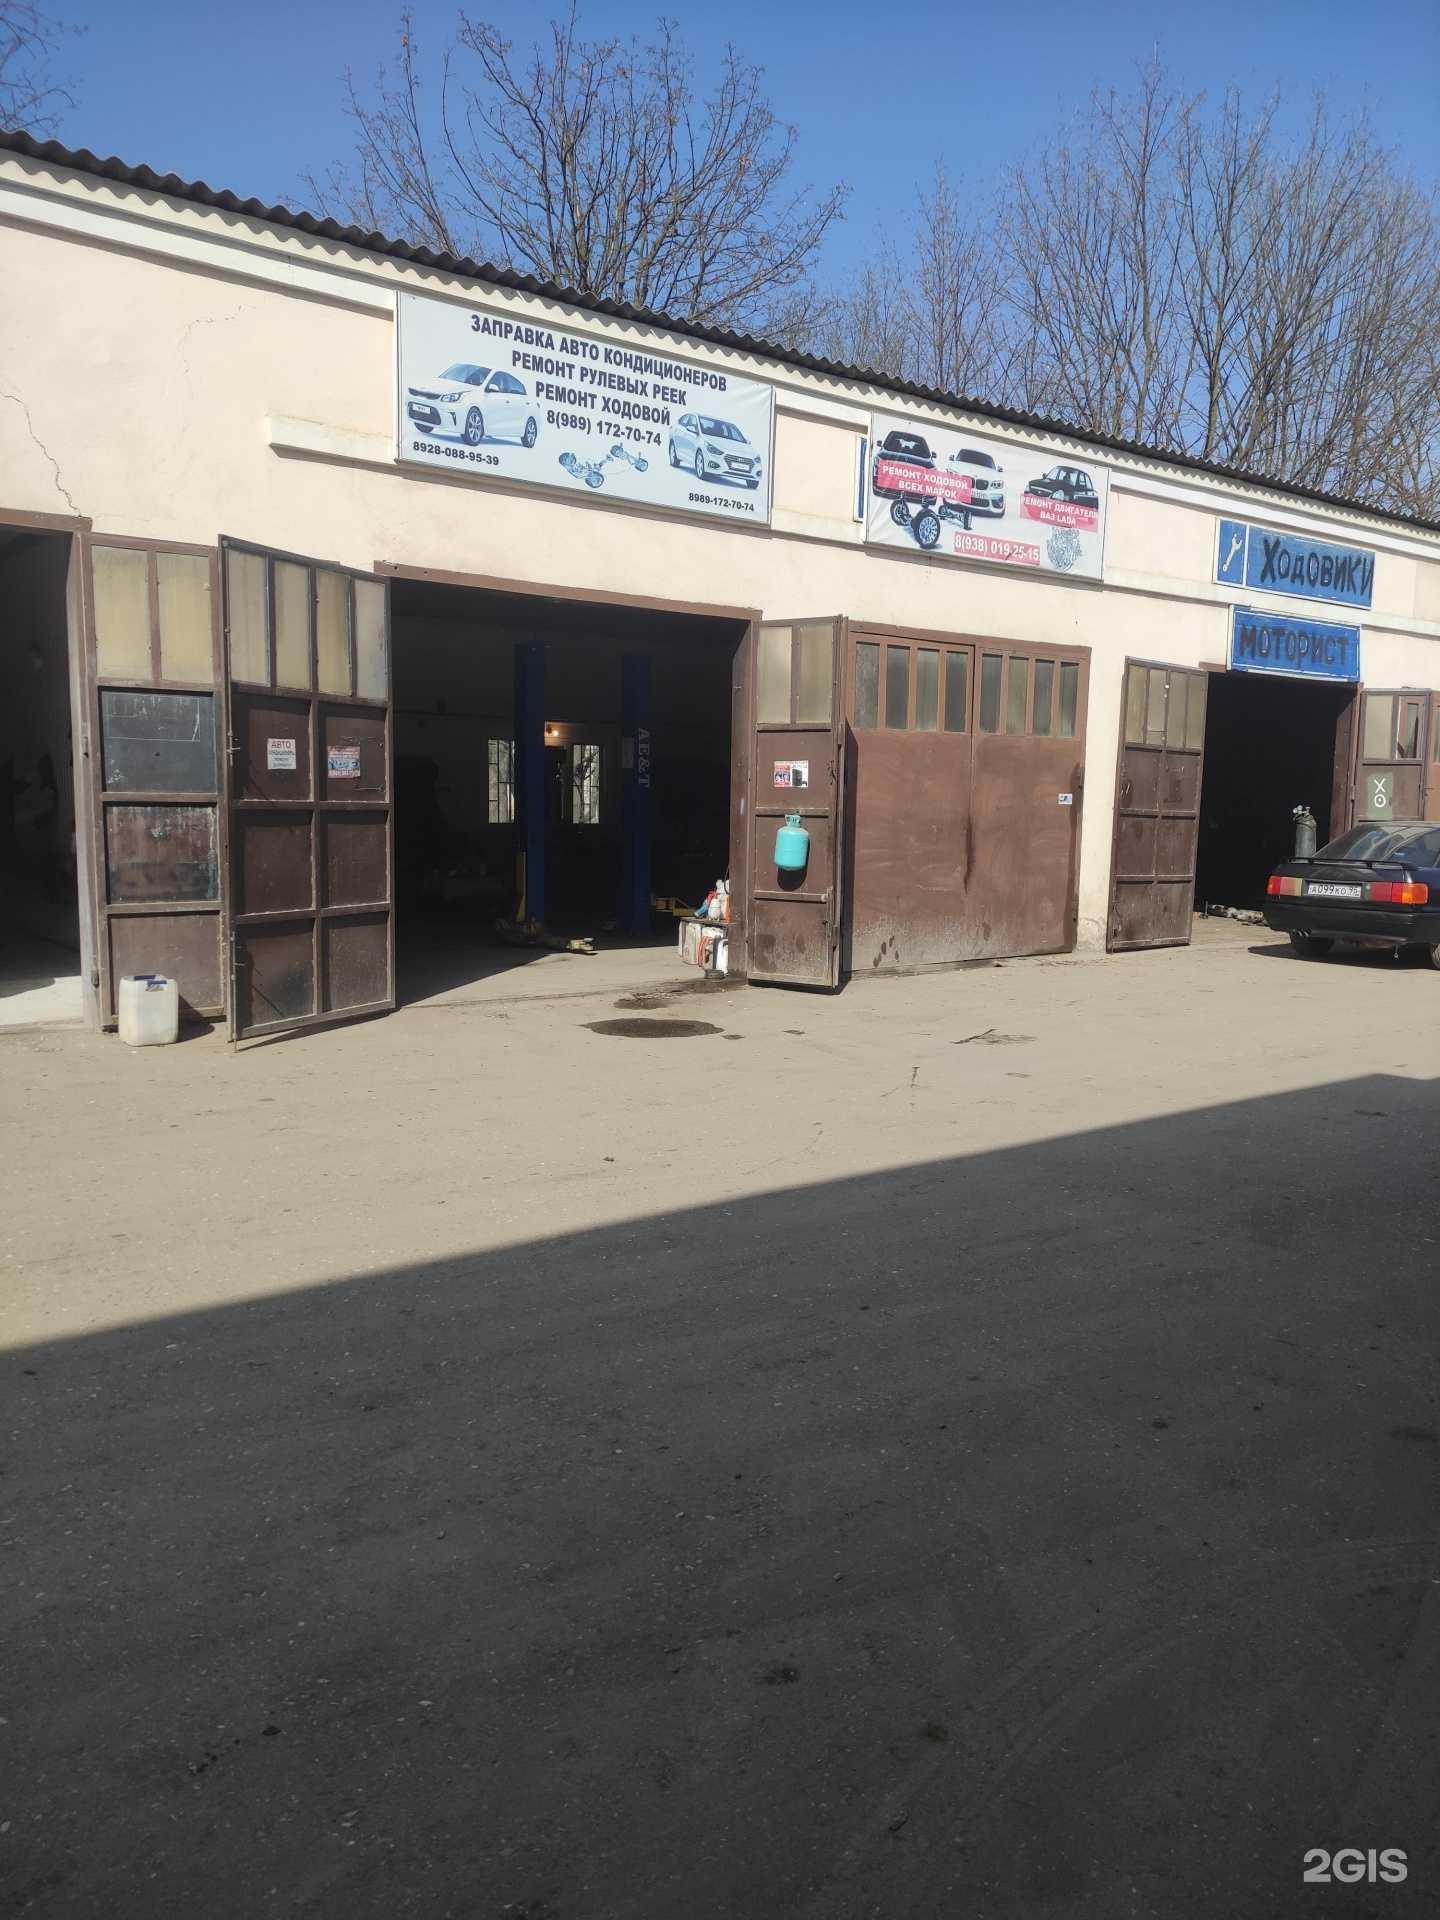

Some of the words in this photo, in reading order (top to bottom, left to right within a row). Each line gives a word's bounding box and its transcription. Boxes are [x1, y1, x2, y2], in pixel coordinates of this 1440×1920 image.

[471, 314, 555, 350] ЗАПРАВКА
[559, 337, 599, 361] АВТО
[604, 348, 727, 392] КОНДИЦИОНЕРОВ
[512, 350, 576, 380] РЕМОНТ
[580, 366, 648, 398] РУЛЕВЫХ
[652, 384, 687, 406] РЕЕК
[535, 381, 597, 410] РЕМОНТ
[601, 396, 671, 427] ХОДОВОЙ
[546, 410, 592, 435] 8(989)
[596, 420, 661, 447] 172-70-74
[413, 441, 499, 466] 8928-088-95-39
[882, 466, 921, 480] РЕМОНТ
[898, 480, 923, 492] ВСЕХ
[925, 485, 957, 499] МАРОК
[688, 492, 755, 512] 8989-172-70-74
[1057, 514, 1076, 526] LADA
[954, 533, 988, 554] 8(938)
[1240, 623, 1349, 669] МОТОРИСТ
[272, 740, 292, 749] АВТО
